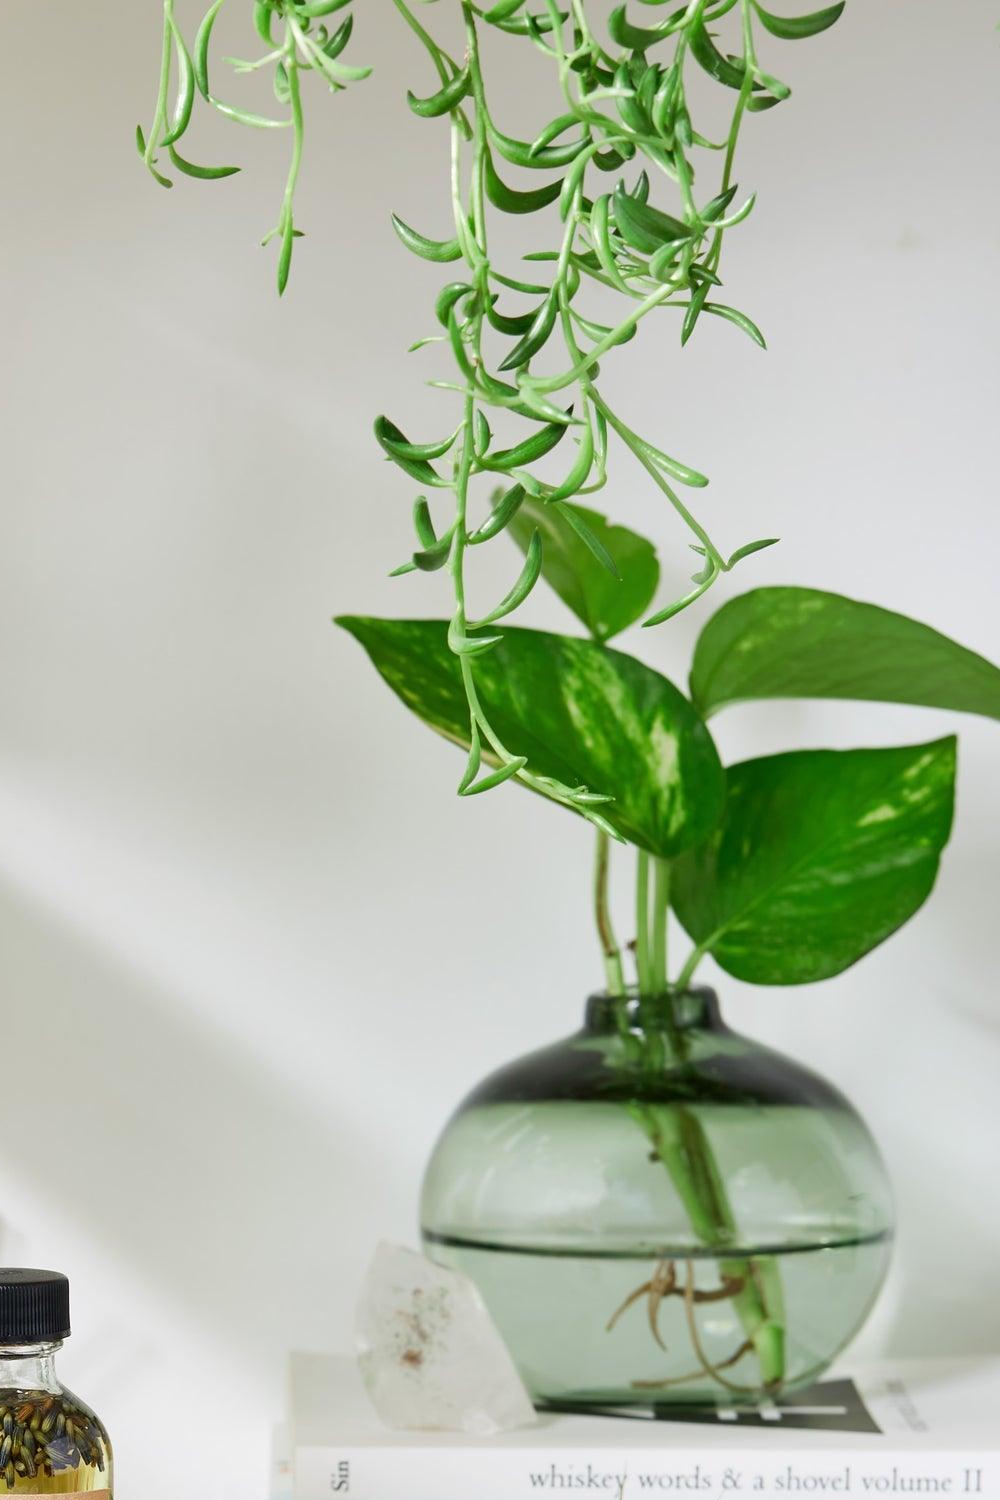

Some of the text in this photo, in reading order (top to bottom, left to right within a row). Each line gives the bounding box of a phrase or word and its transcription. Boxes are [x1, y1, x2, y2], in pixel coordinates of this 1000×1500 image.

[330, 1460, 350, 1493] Sin
[529, 1464, 982, 1500] whiskey words & a shovel volume II
